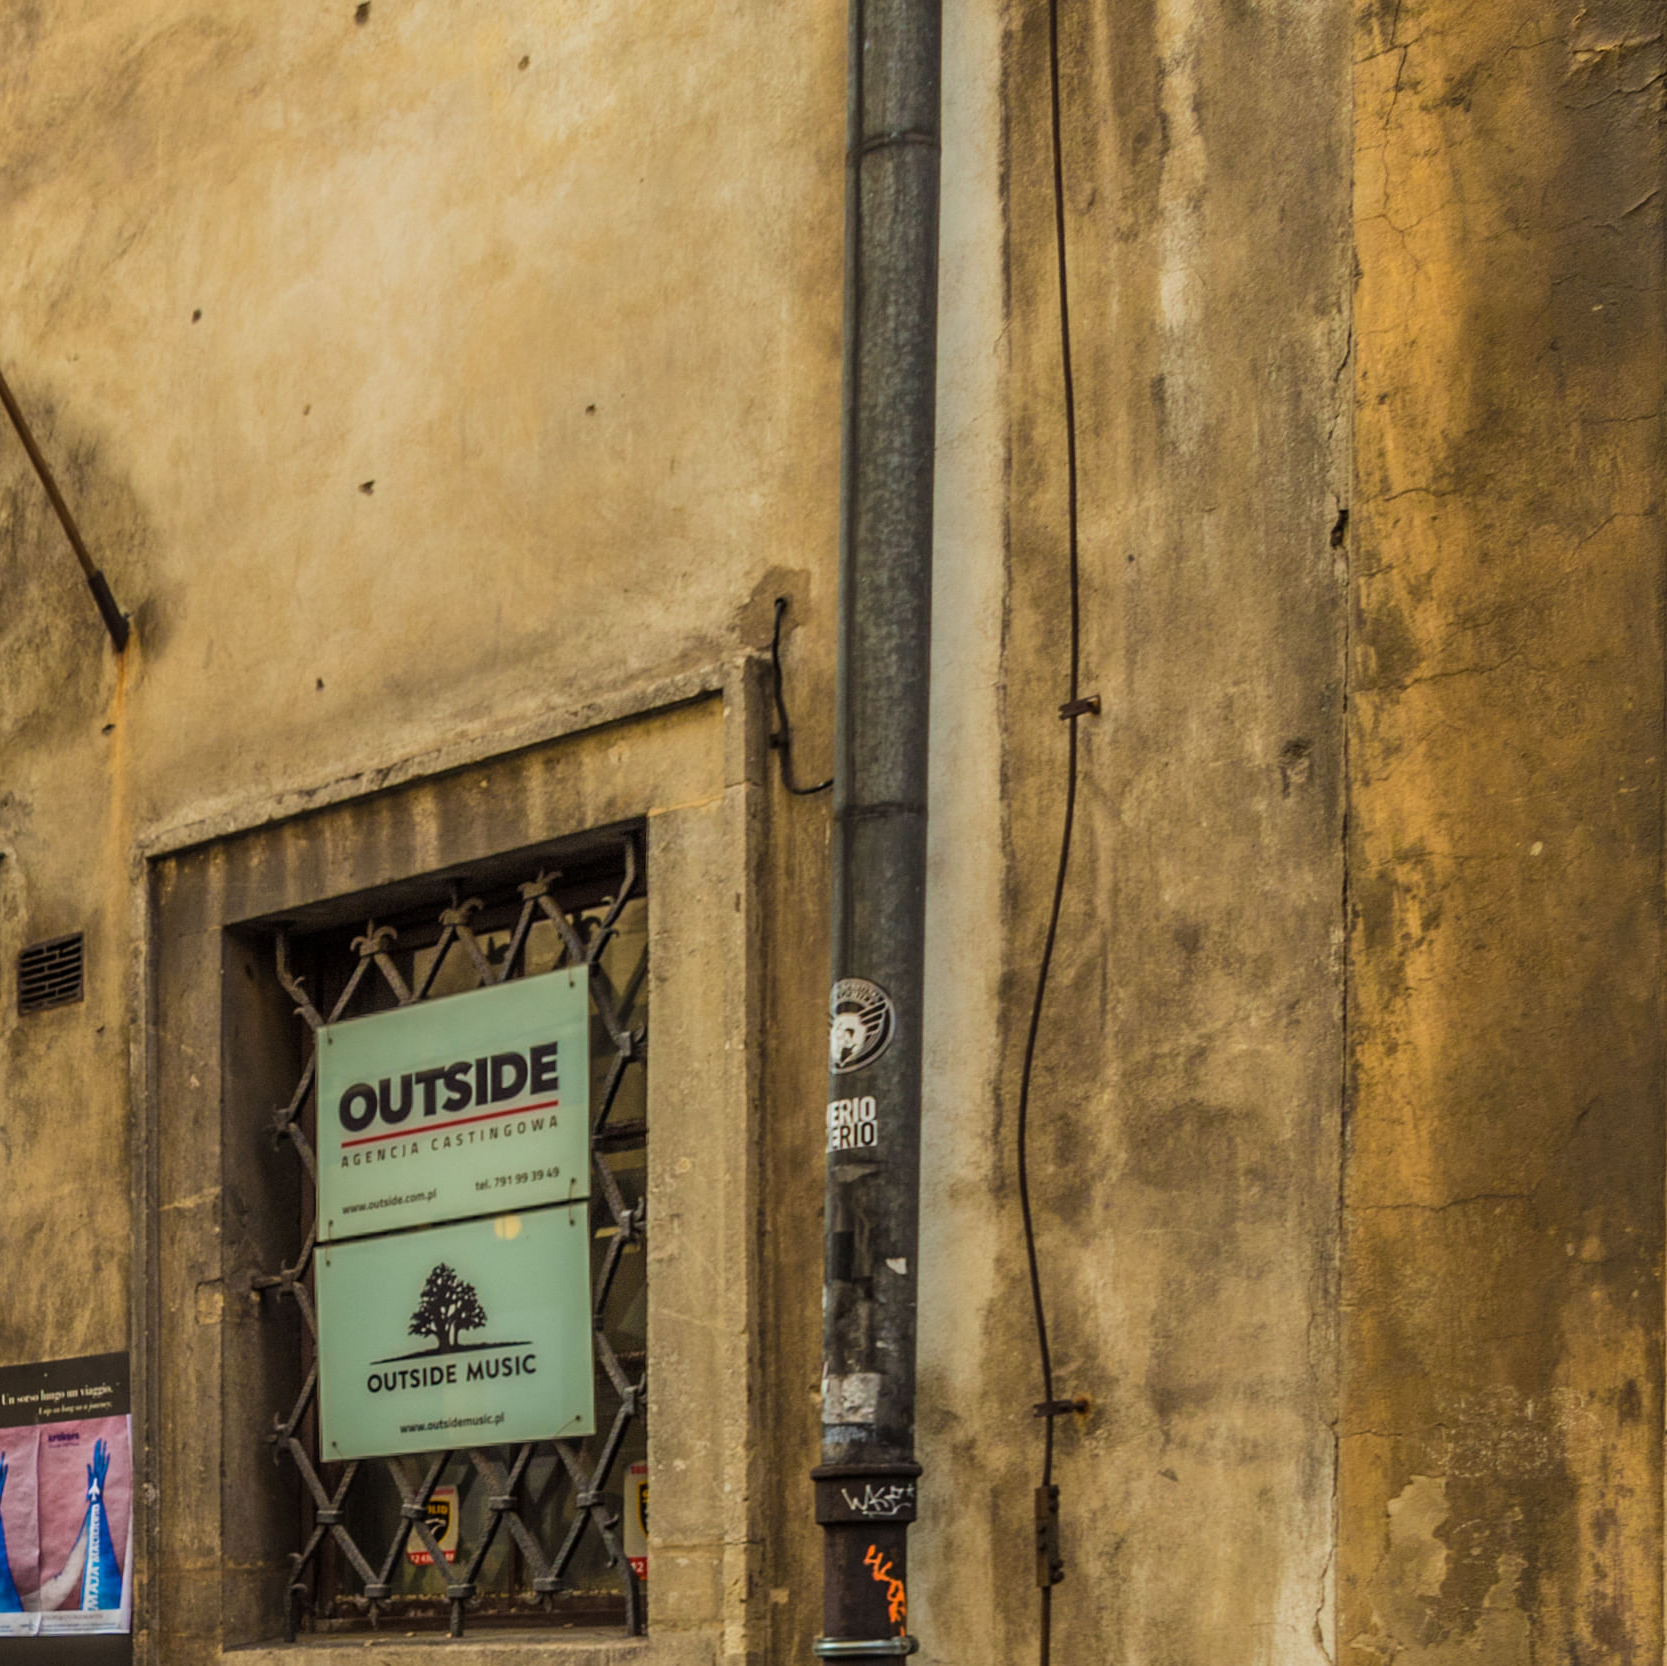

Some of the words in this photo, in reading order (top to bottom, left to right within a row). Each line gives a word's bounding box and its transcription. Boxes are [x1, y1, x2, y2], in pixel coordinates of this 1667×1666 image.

[339, 1041, 559, 1132] OUTSIDE
[341, 1142, 419, 1168] AGENCJA
[431, 1115, 558, 1151] CASTINGOWA
[475, 1179, 491, 1192] tel.
[494, 1174, 512, 1190] 791
[515, 1172, 529, 1185] 99
[531, 1169, 545, 1183] 39
[546, 1166, 560, 1180] 49
[342, 1188, 437, 1215] www.outside.com.pl
[367, 1364, 457, 1393] OUTSIDE
[466, 1354, 536, 1382] MUSIC
[400, 1412, 505, 1433] www.outsidemusic.pl
